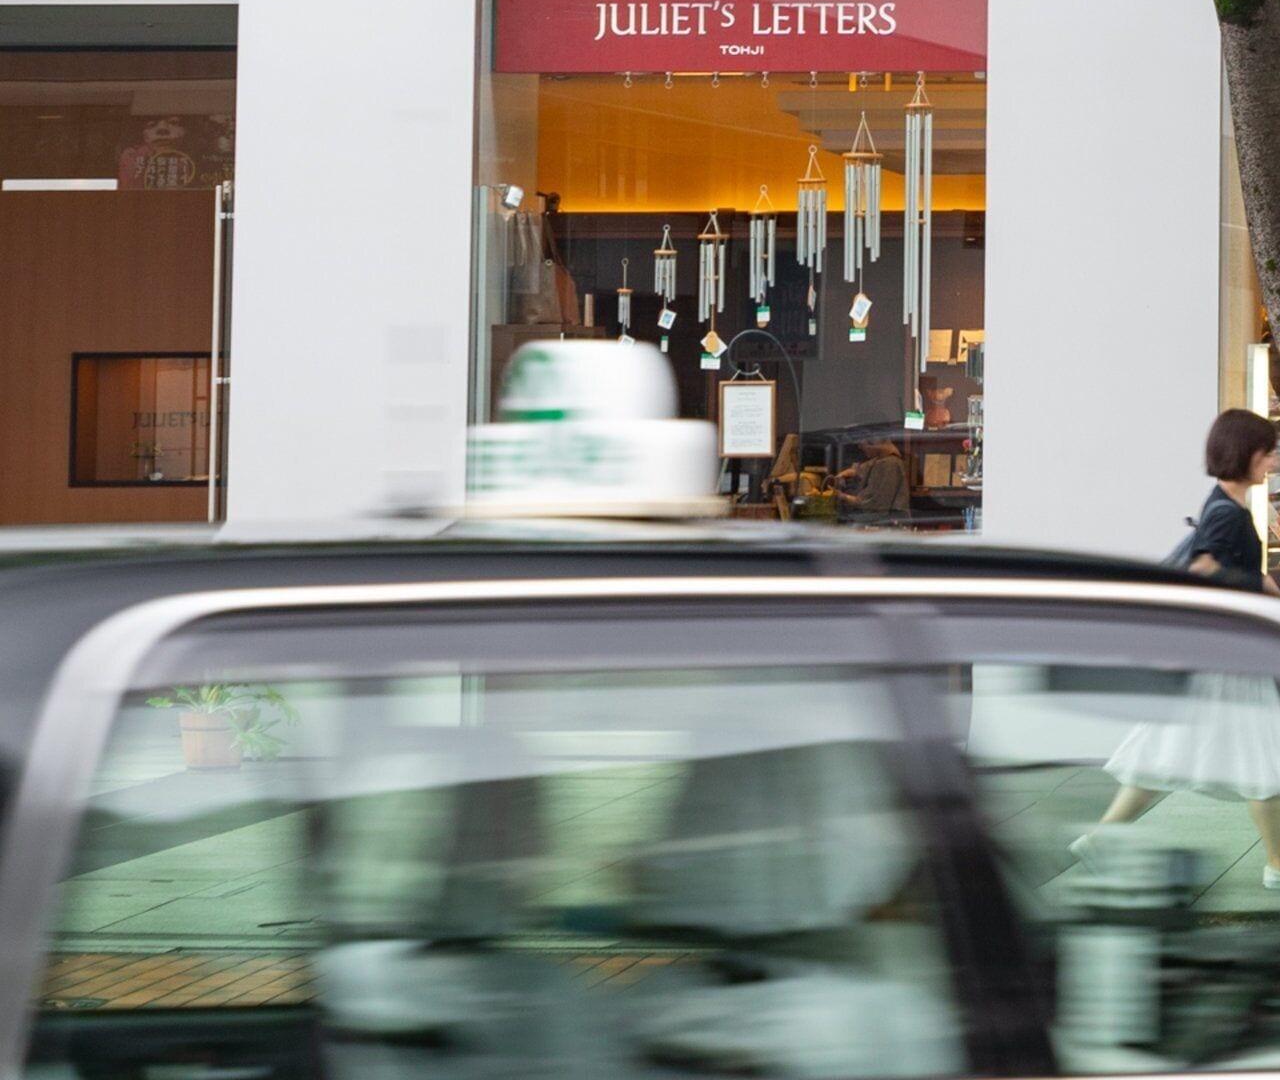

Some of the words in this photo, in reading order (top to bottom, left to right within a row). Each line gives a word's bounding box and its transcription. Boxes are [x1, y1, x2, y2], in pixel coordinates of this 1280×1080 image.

[594, 0, 736, 40] JULIET'S
[752, 2, 897, 35] LETTERS
[719, 45, 764, 56] TOHJI
